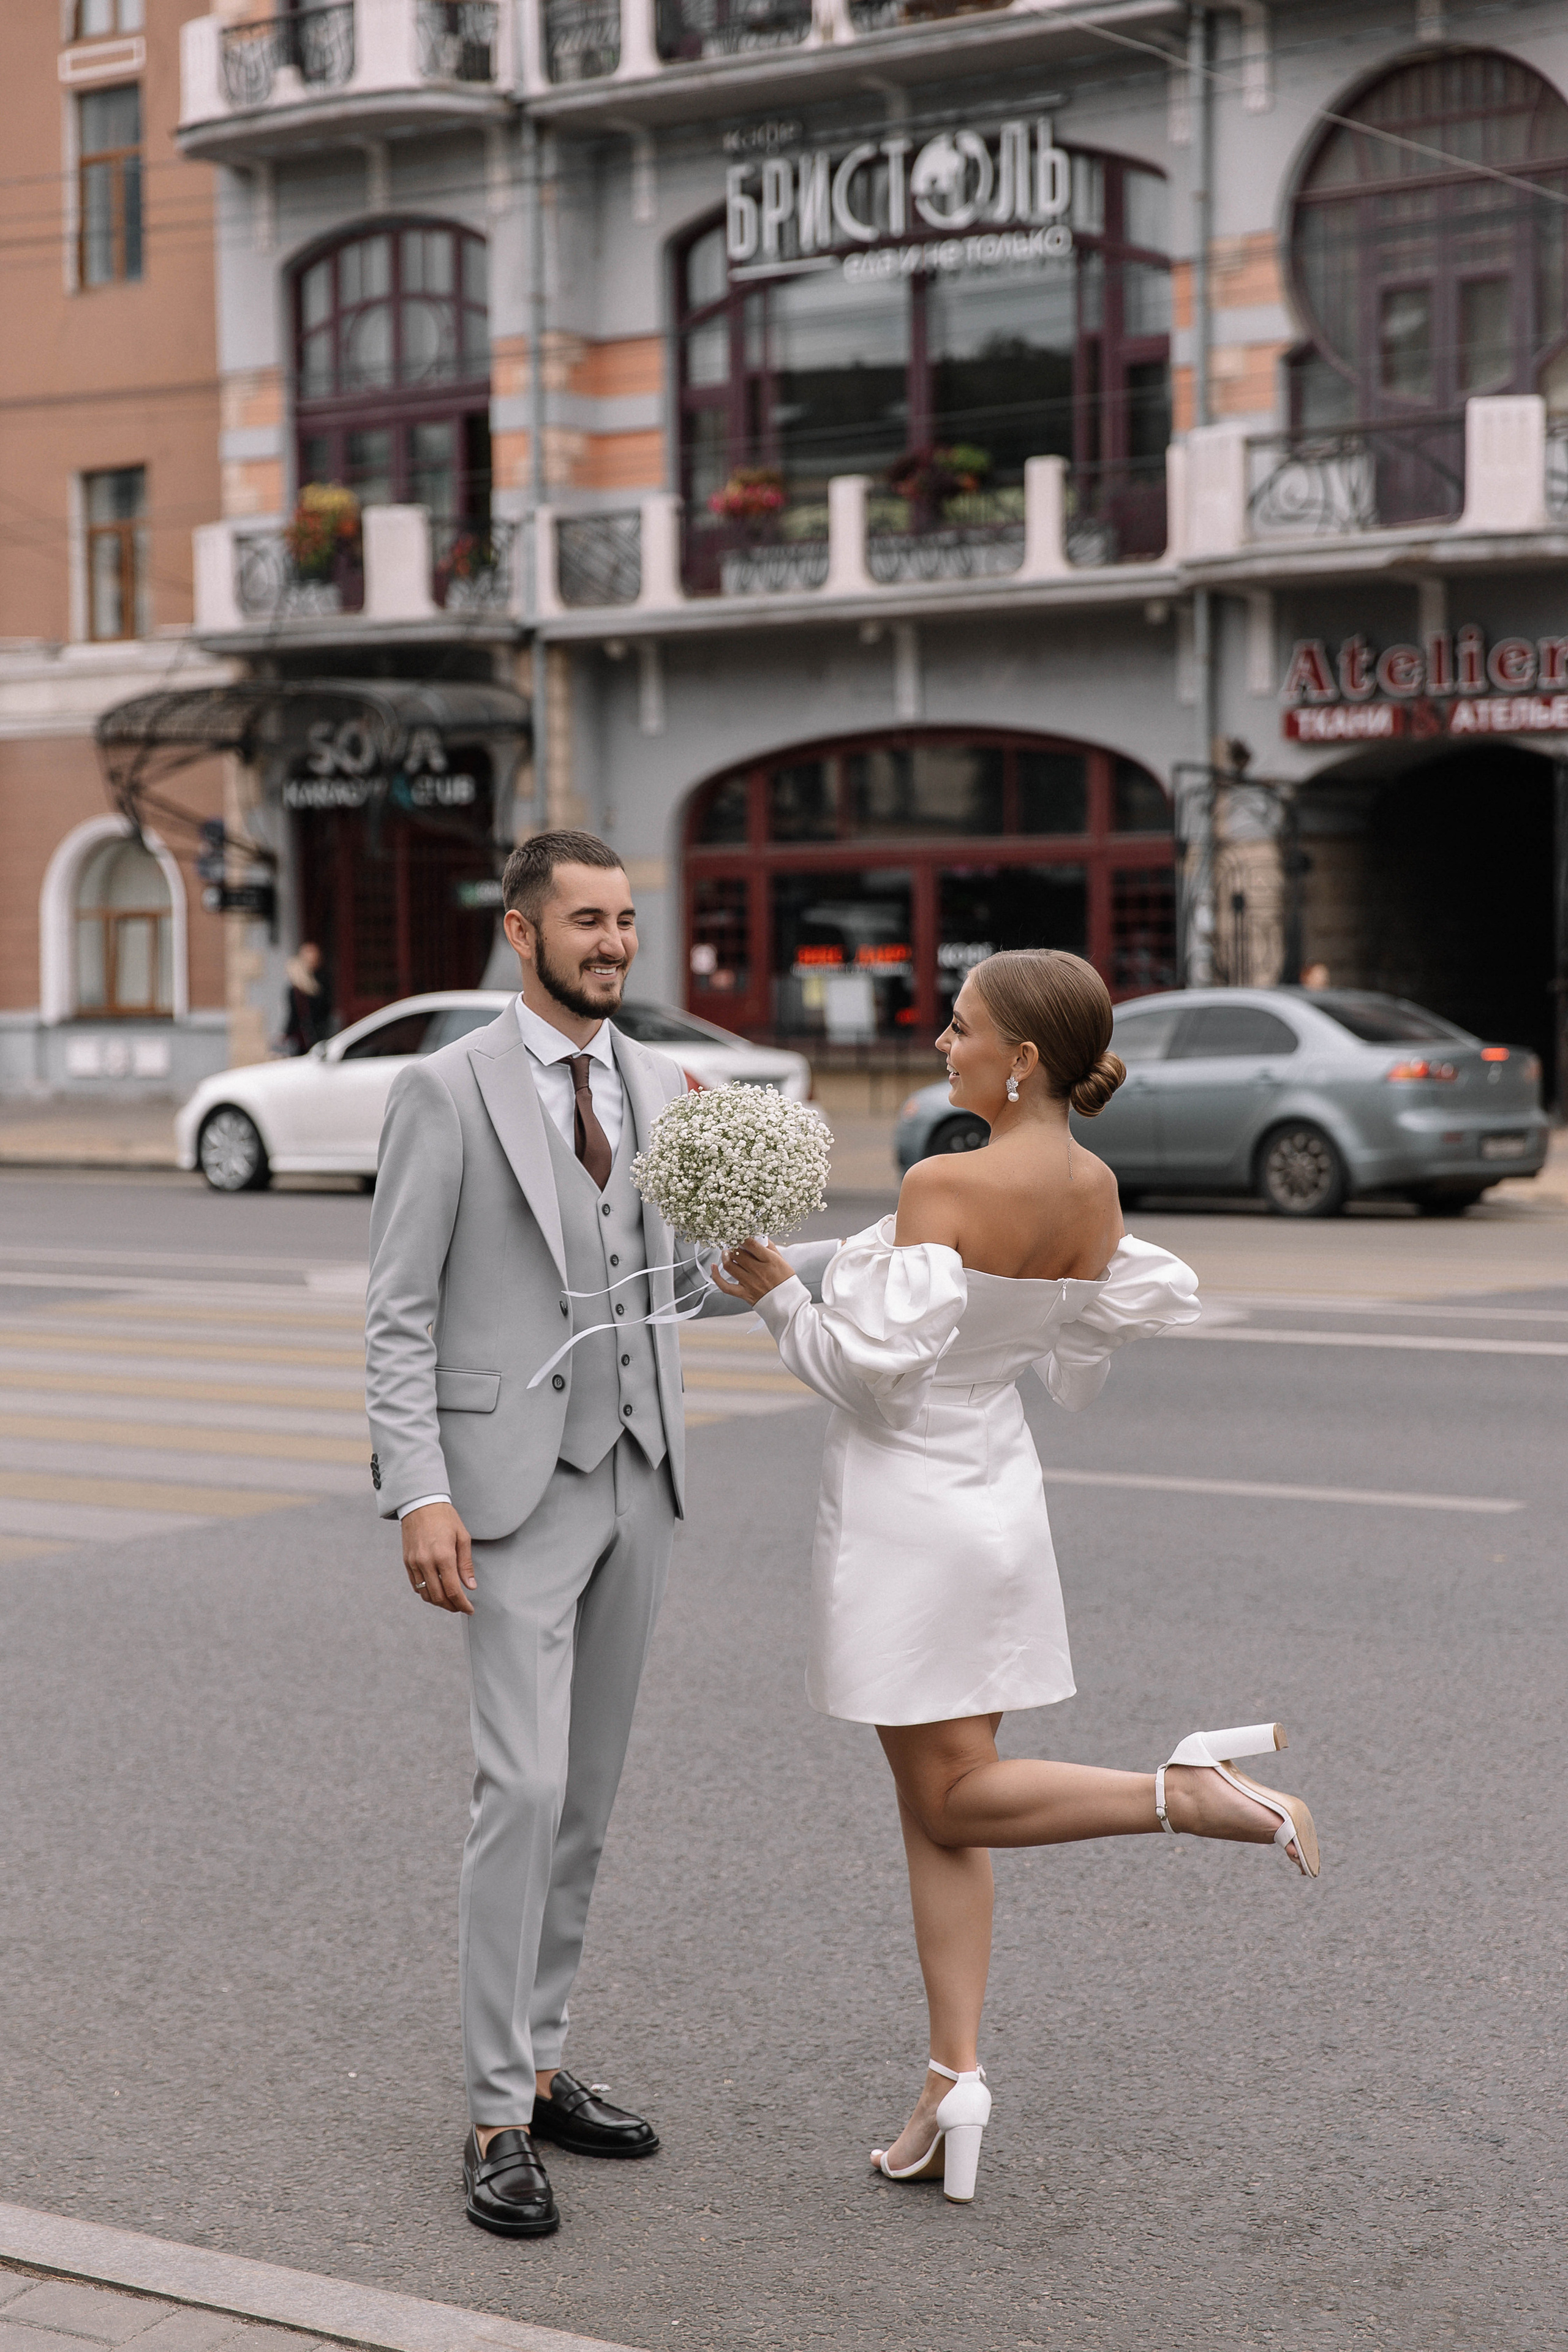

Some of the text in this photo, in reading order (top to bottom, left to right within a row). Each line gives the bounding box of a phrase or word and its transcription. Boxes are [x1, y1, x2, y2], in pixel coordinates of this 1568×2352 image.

[726, 118, 1072, 262] БРИСТОЛЬ
[1279, 624, 1568, 704] Atelier
[1296, 704, 1394, 739] ТКАНИ
